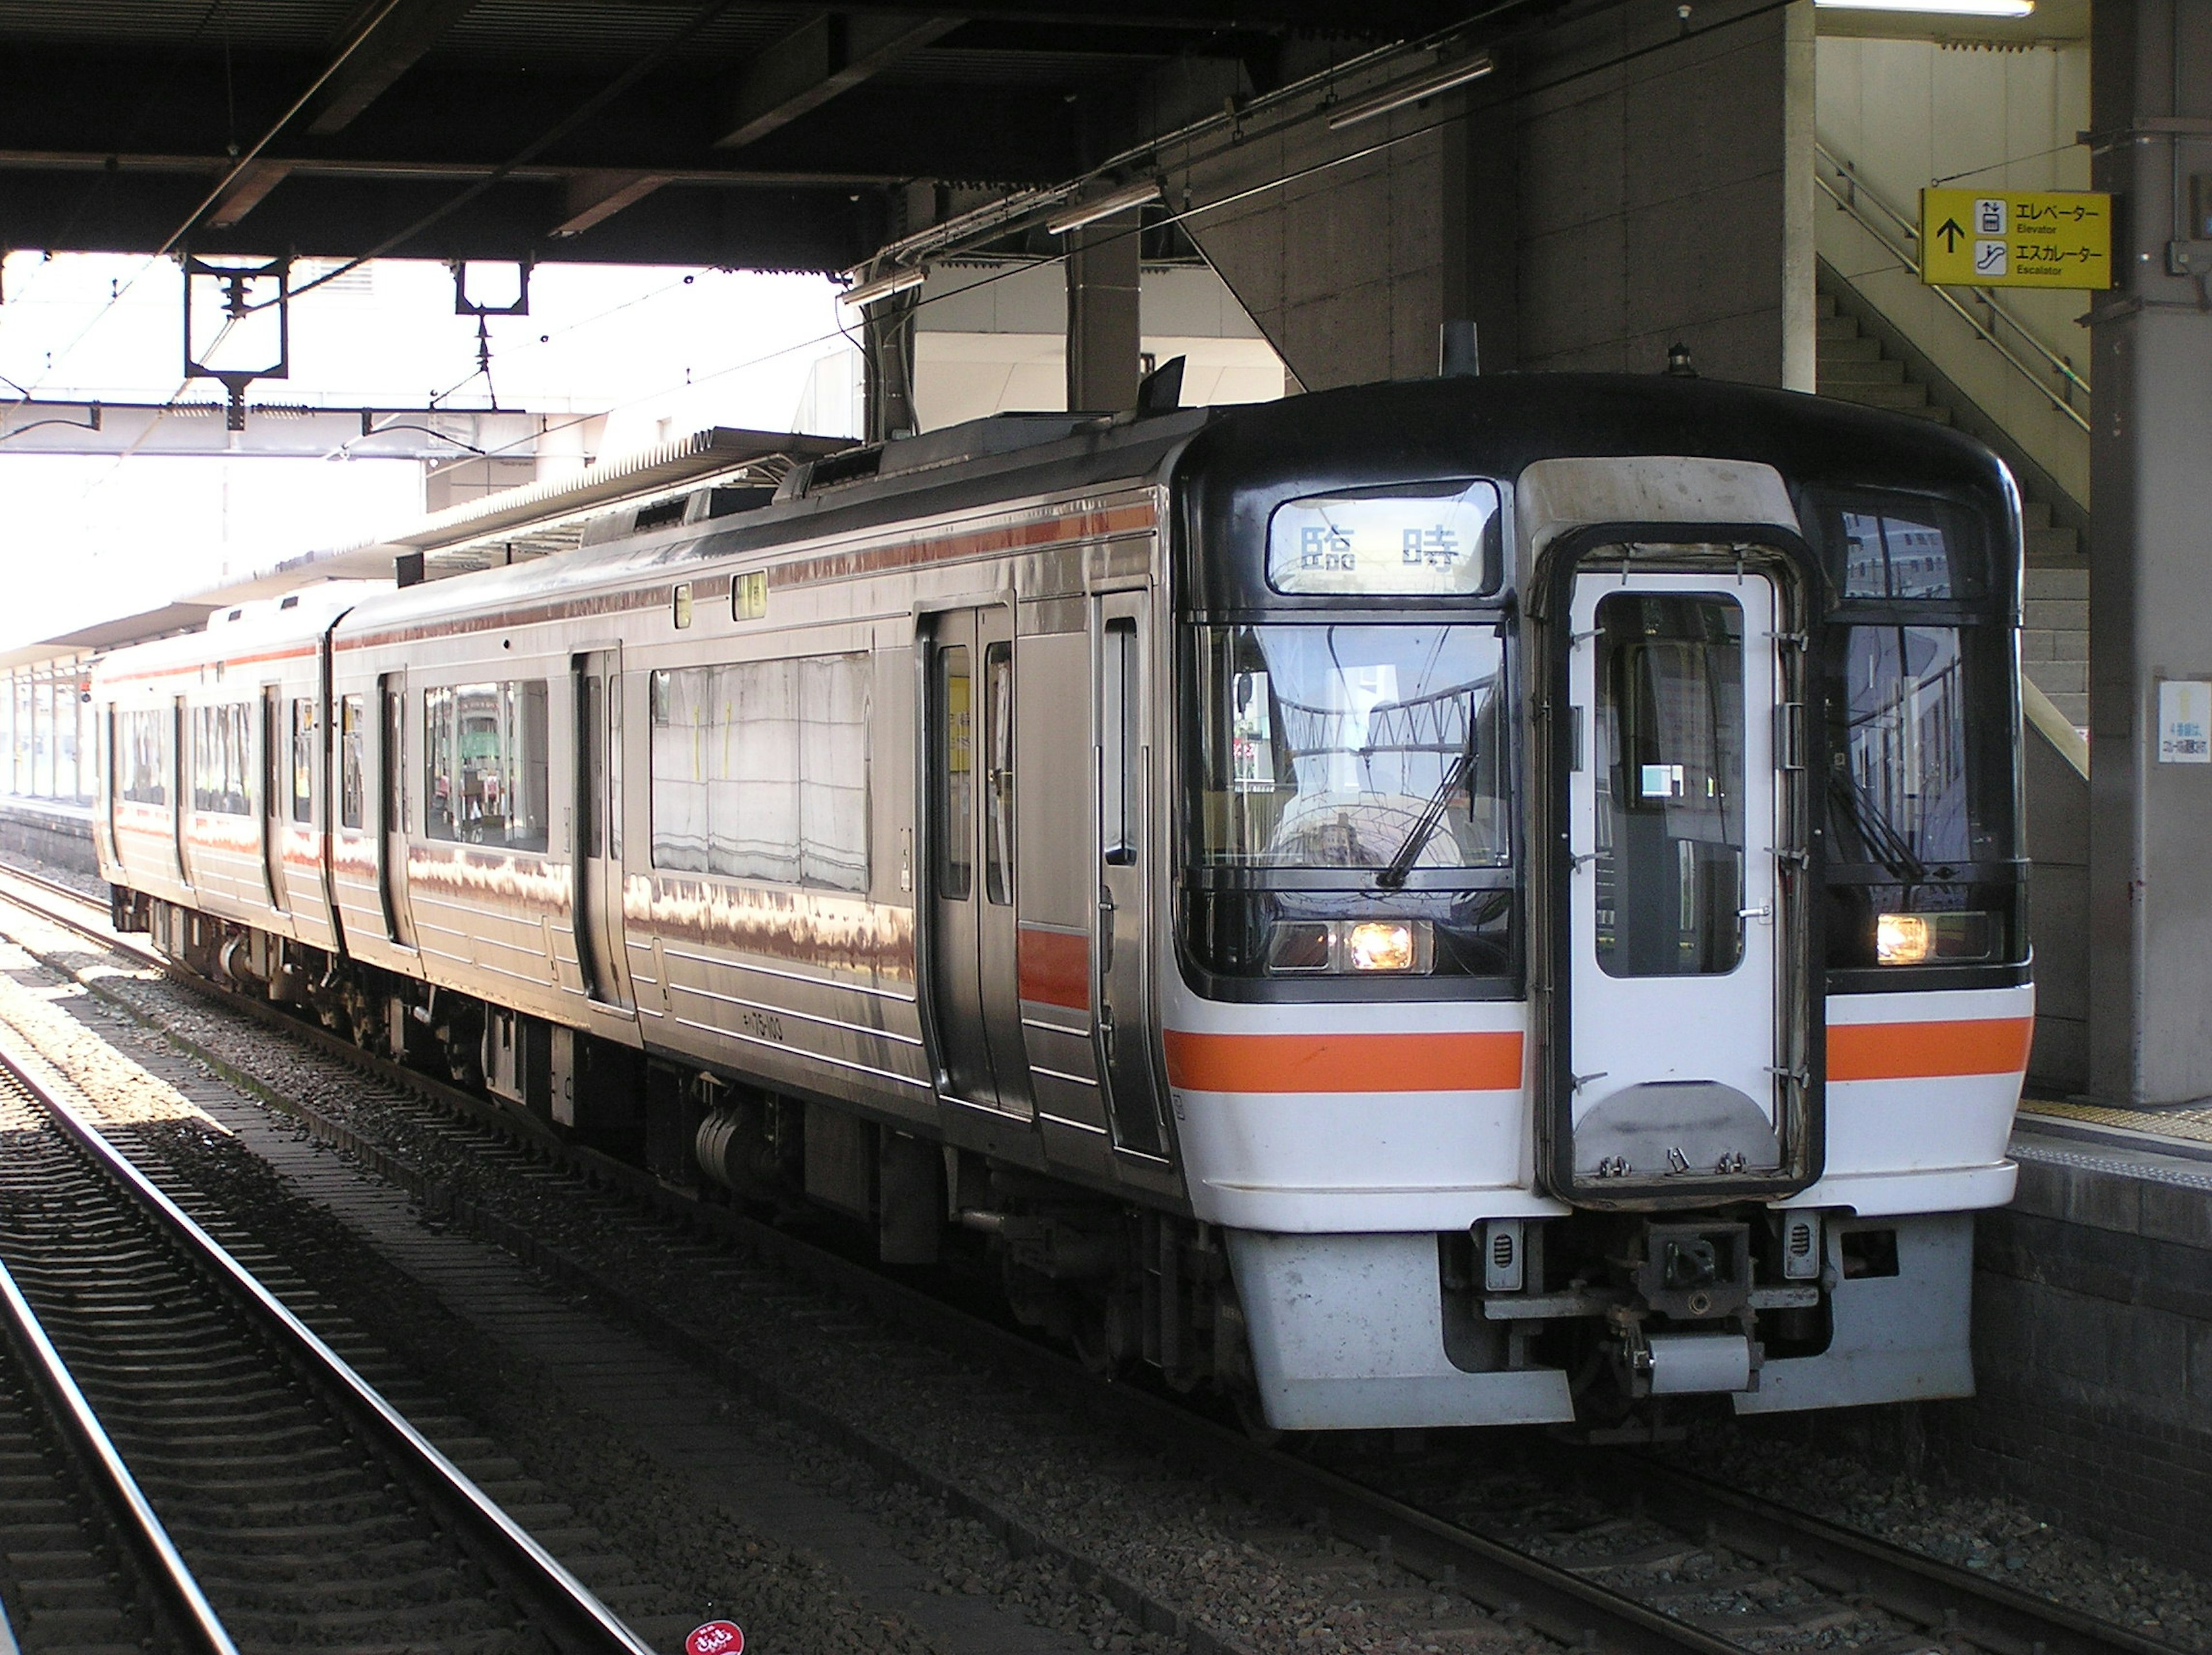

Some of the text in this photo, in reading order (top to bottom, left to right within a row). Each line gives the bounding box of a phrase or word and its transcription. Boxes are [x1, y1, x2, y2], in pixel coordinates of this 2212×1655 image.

[2016, 203, 2099, 221] エレベーター
[2017, 224, 2056, 234] Elevator
[2016, 244, 2102, 263] エスカレーター
[2017, 264, 2062, 275] Escalator
